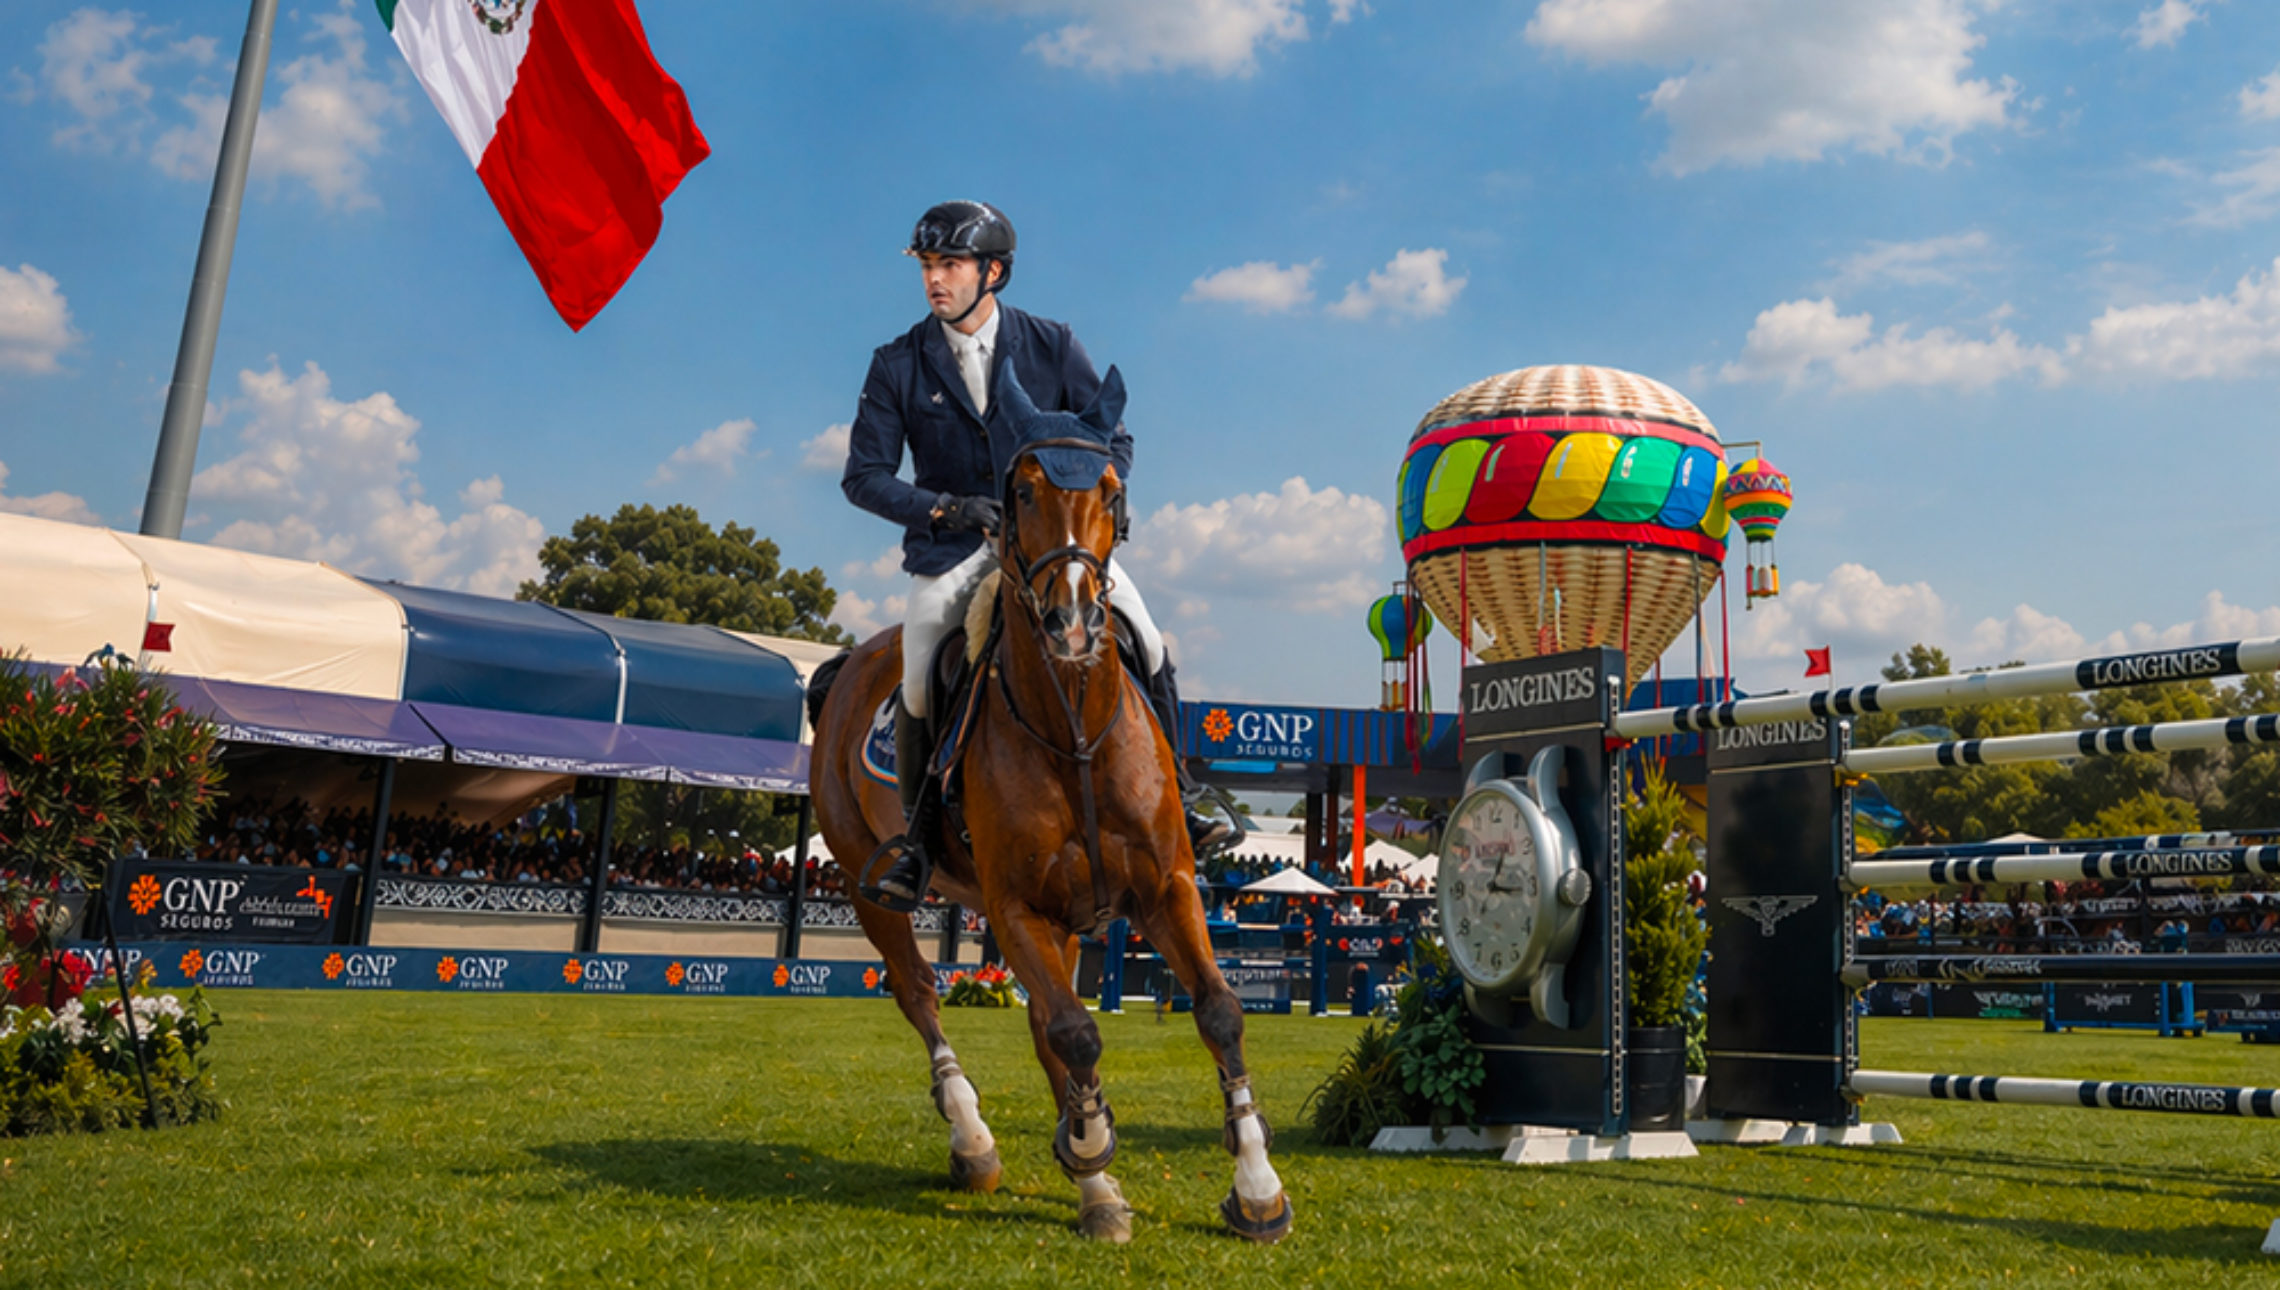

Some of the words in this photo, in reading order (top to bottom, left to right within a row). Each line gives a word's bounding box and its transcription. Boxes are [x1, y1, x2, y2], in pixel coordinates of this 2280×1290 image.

[2092, 648, 2222, 685] LONGINES
[1470, 666, 1596, 713] LONGINES
[1237, 711, 1313, 744] GNP
[1717, 717, 1828, 750] LONGINES
[2126, 852, 2233, 874] LONGINES
[164, 877, 239, 913] GNP
[160, 913, 233, 930] SEGUROS
[206, 950, 260, 974] GNP
[346, 954, 398, 976] GNP
[460, 957, 509, 979] GNP
[584, 960, 630, 981] GNP
[686, 963, 728, 983] GNP
[791, 966, 831, 985] GNP
[2121, 1085, 2227, 1112] LONGINES
